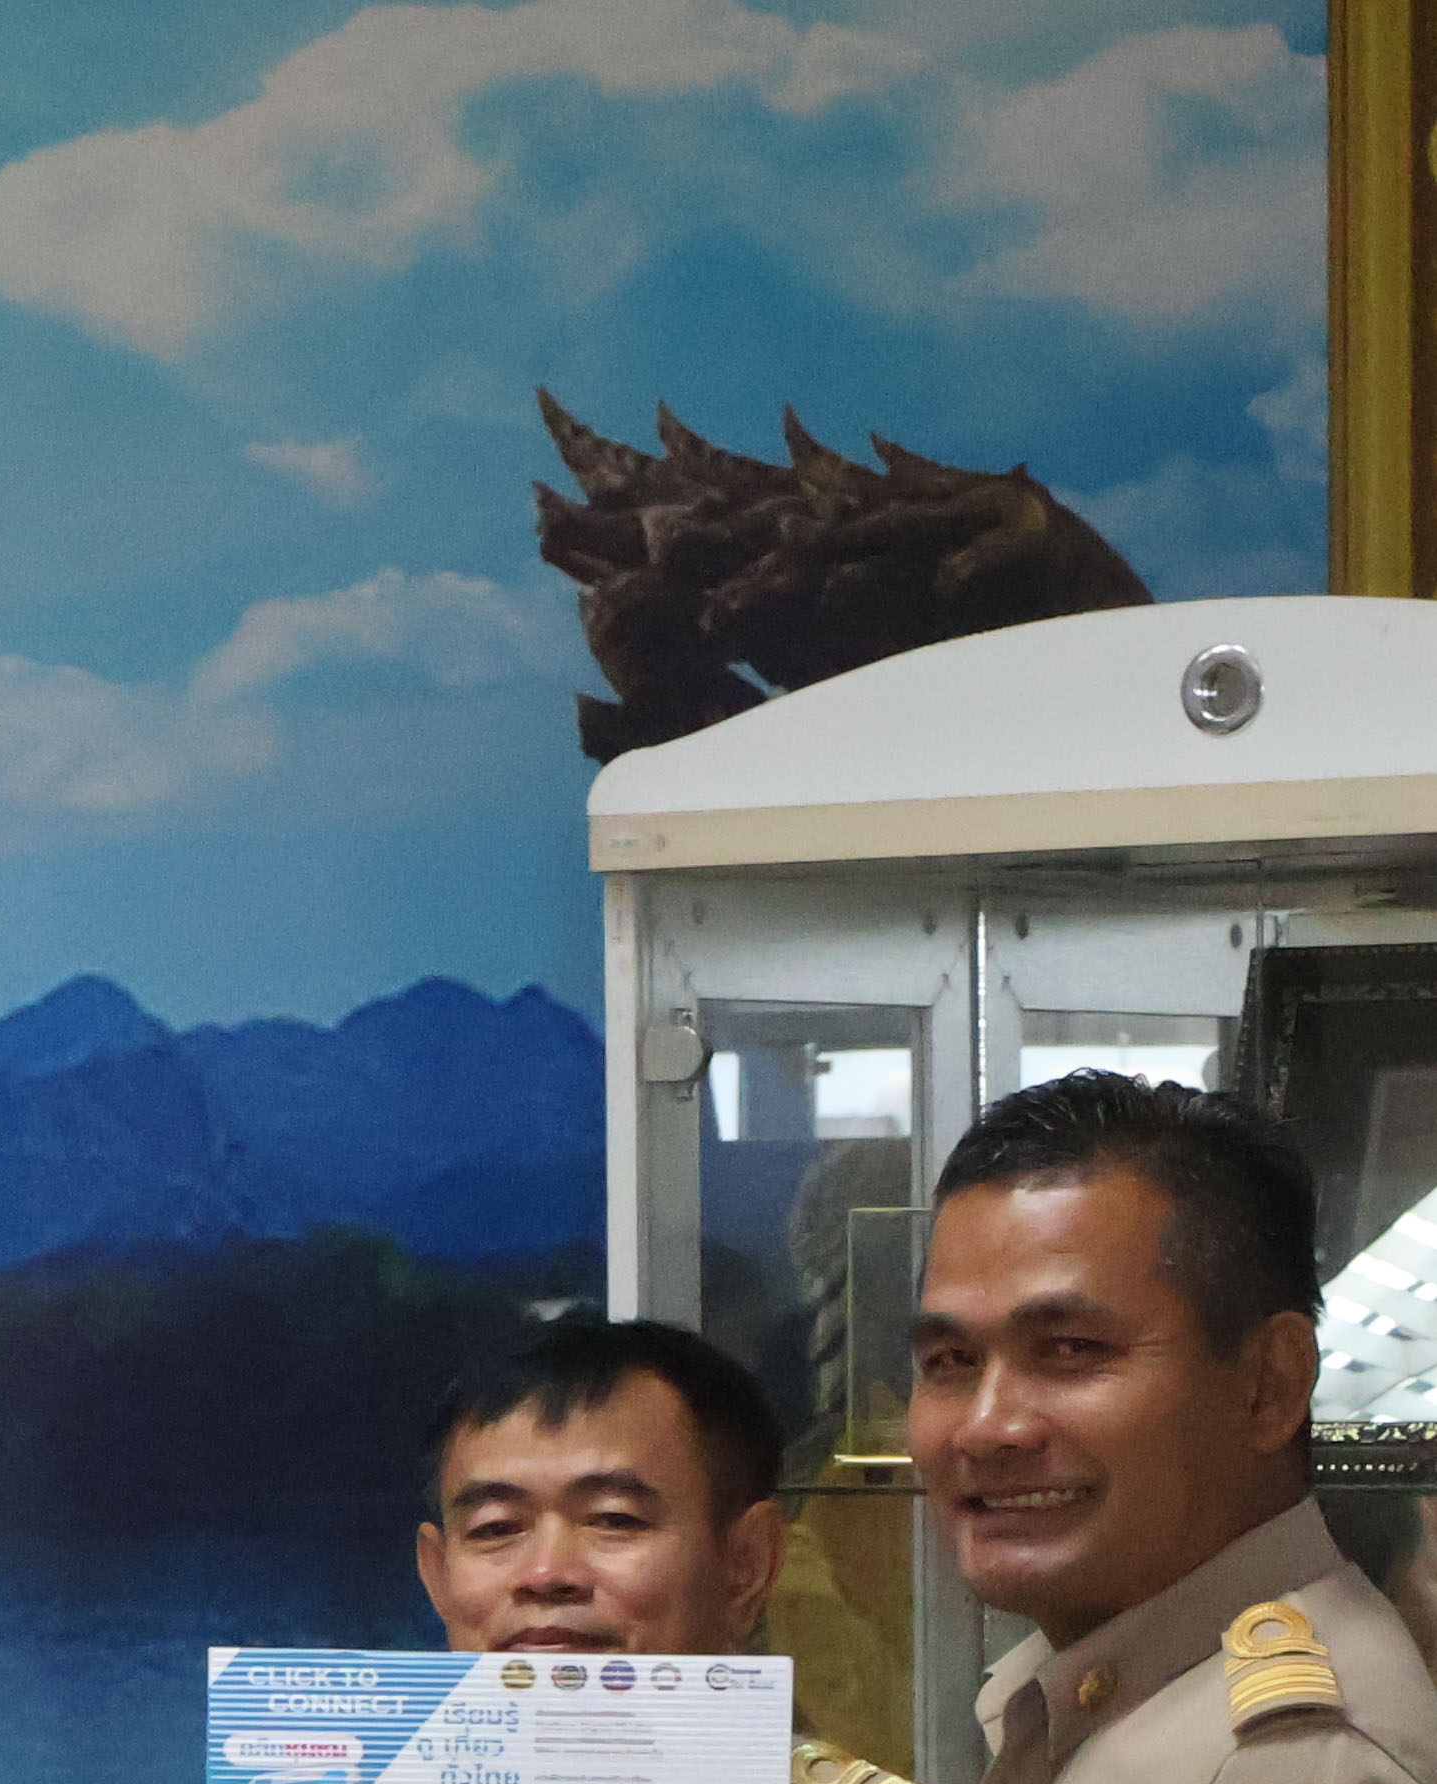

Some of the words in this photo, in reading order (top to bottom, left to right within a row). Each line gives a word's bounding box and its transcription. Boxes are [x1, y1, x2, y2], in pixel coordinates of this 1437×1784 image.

[247, 1666, 334, 1687] CLICK
[342, 1667, 380, 1688] TO
[267, 1692, 410, 1715] CONNECT
